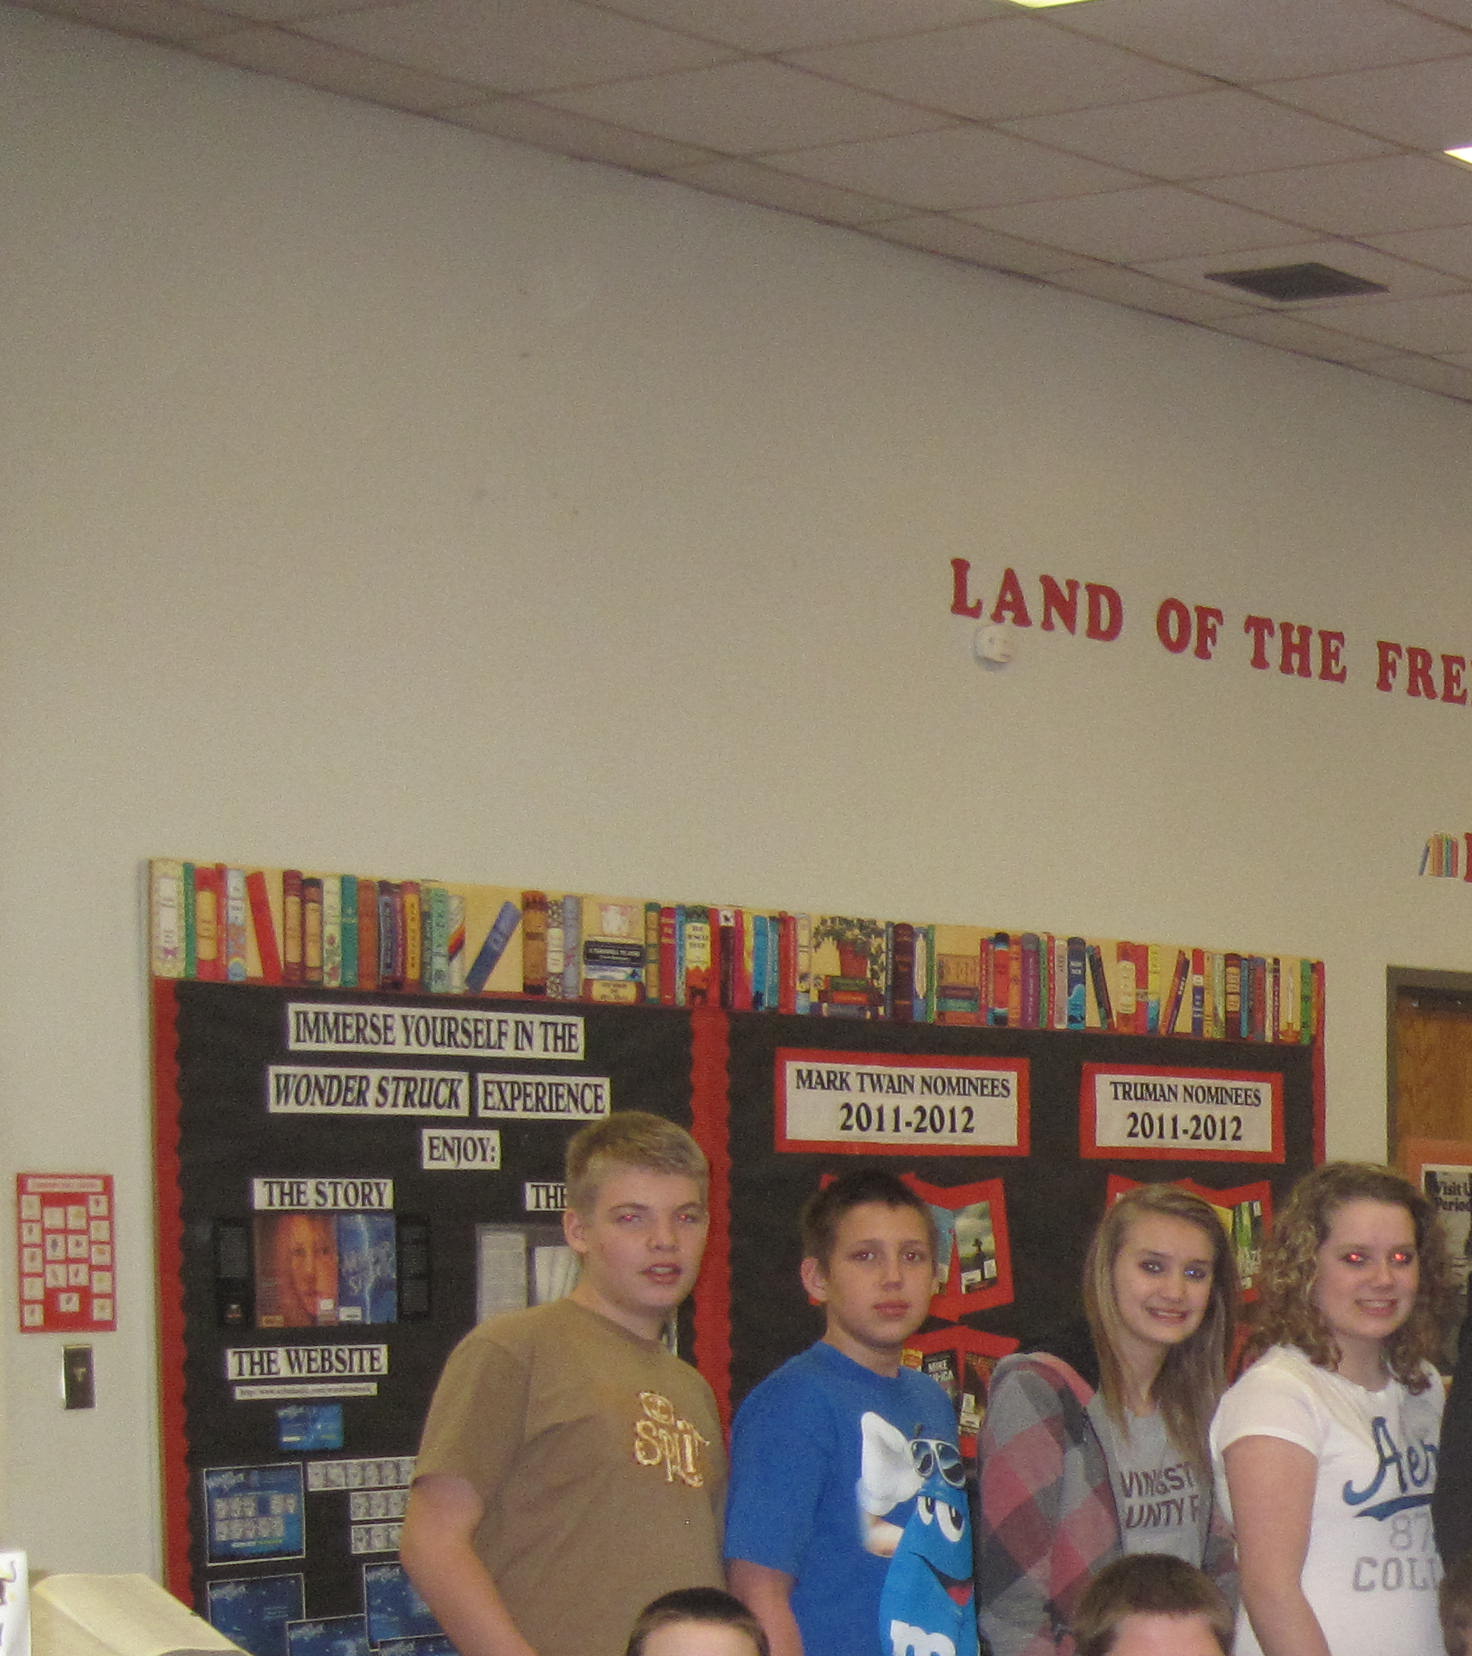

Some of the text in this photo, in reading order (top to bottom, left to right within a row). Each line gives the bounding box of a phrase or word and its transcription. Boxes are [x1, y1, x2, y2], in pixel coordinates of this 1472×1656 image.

[952, 557, 1123, 642] LAND
[1157, 598, 1224, 660] OF
[1245, 615, 1347, 683] THE
[295, 1010, 580, 1053] IMMERSE YOURSELF IN THE
[274, 1073, 464, 1110] WONDER STRUCK
[482, 1080, 606, 1114] EXPERIENCE
[796, 1069, 1011, 1099] MARK TWAIN NOMINEES
[1109, 1081, 1263, 1108] TRUMAN NOMINEES
[839, 1102, 975, 1135] 2011-2012
[1126, 1111, 1243, 1142] 2011-2012
[428, 1135, 497, 1167] ENJOY:
[263, 1180, 388, 1208] THE STORY
[233, 1347, 384, 1377] THE WEBSITE
